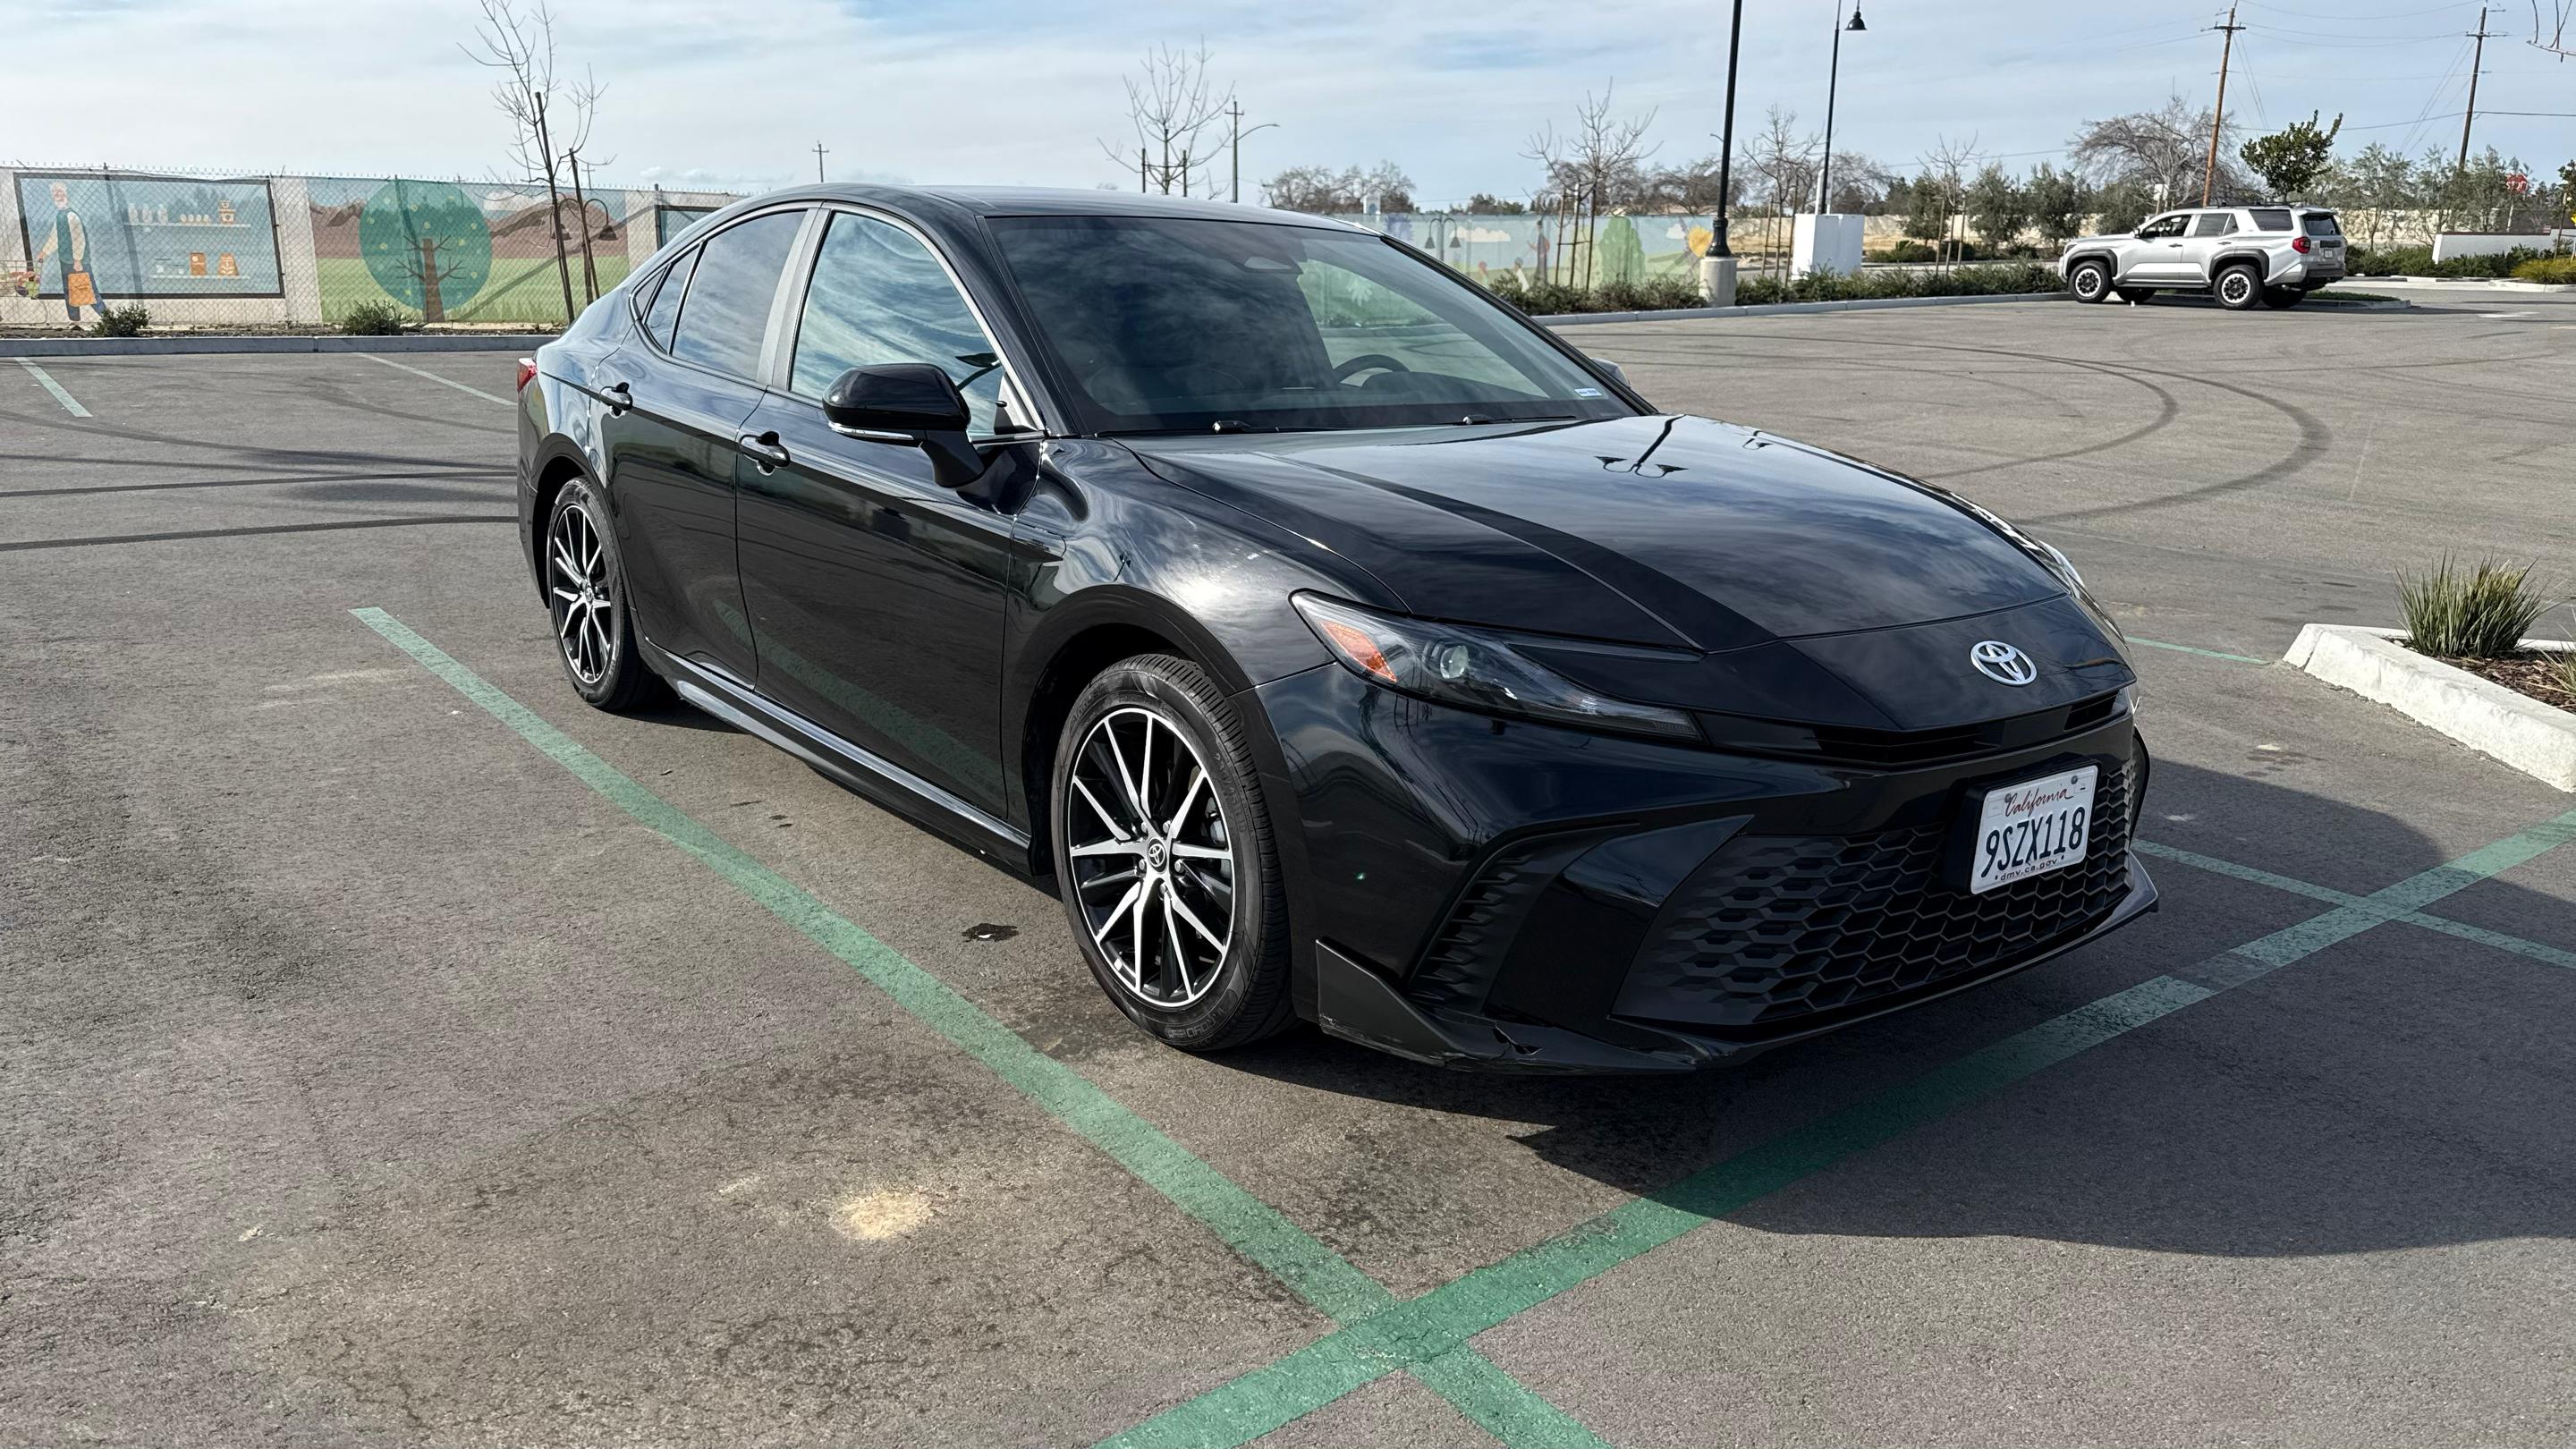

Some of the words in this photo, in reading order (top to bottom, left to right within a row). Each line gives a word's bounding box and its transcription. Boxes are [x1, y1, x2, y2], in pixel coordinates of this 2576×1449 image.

[2004, 787, 2074, 817] California
[1981, 807, 2086, 878] 9SZX118
[2001, 859, 2057, 881] dmv.ca.gov
